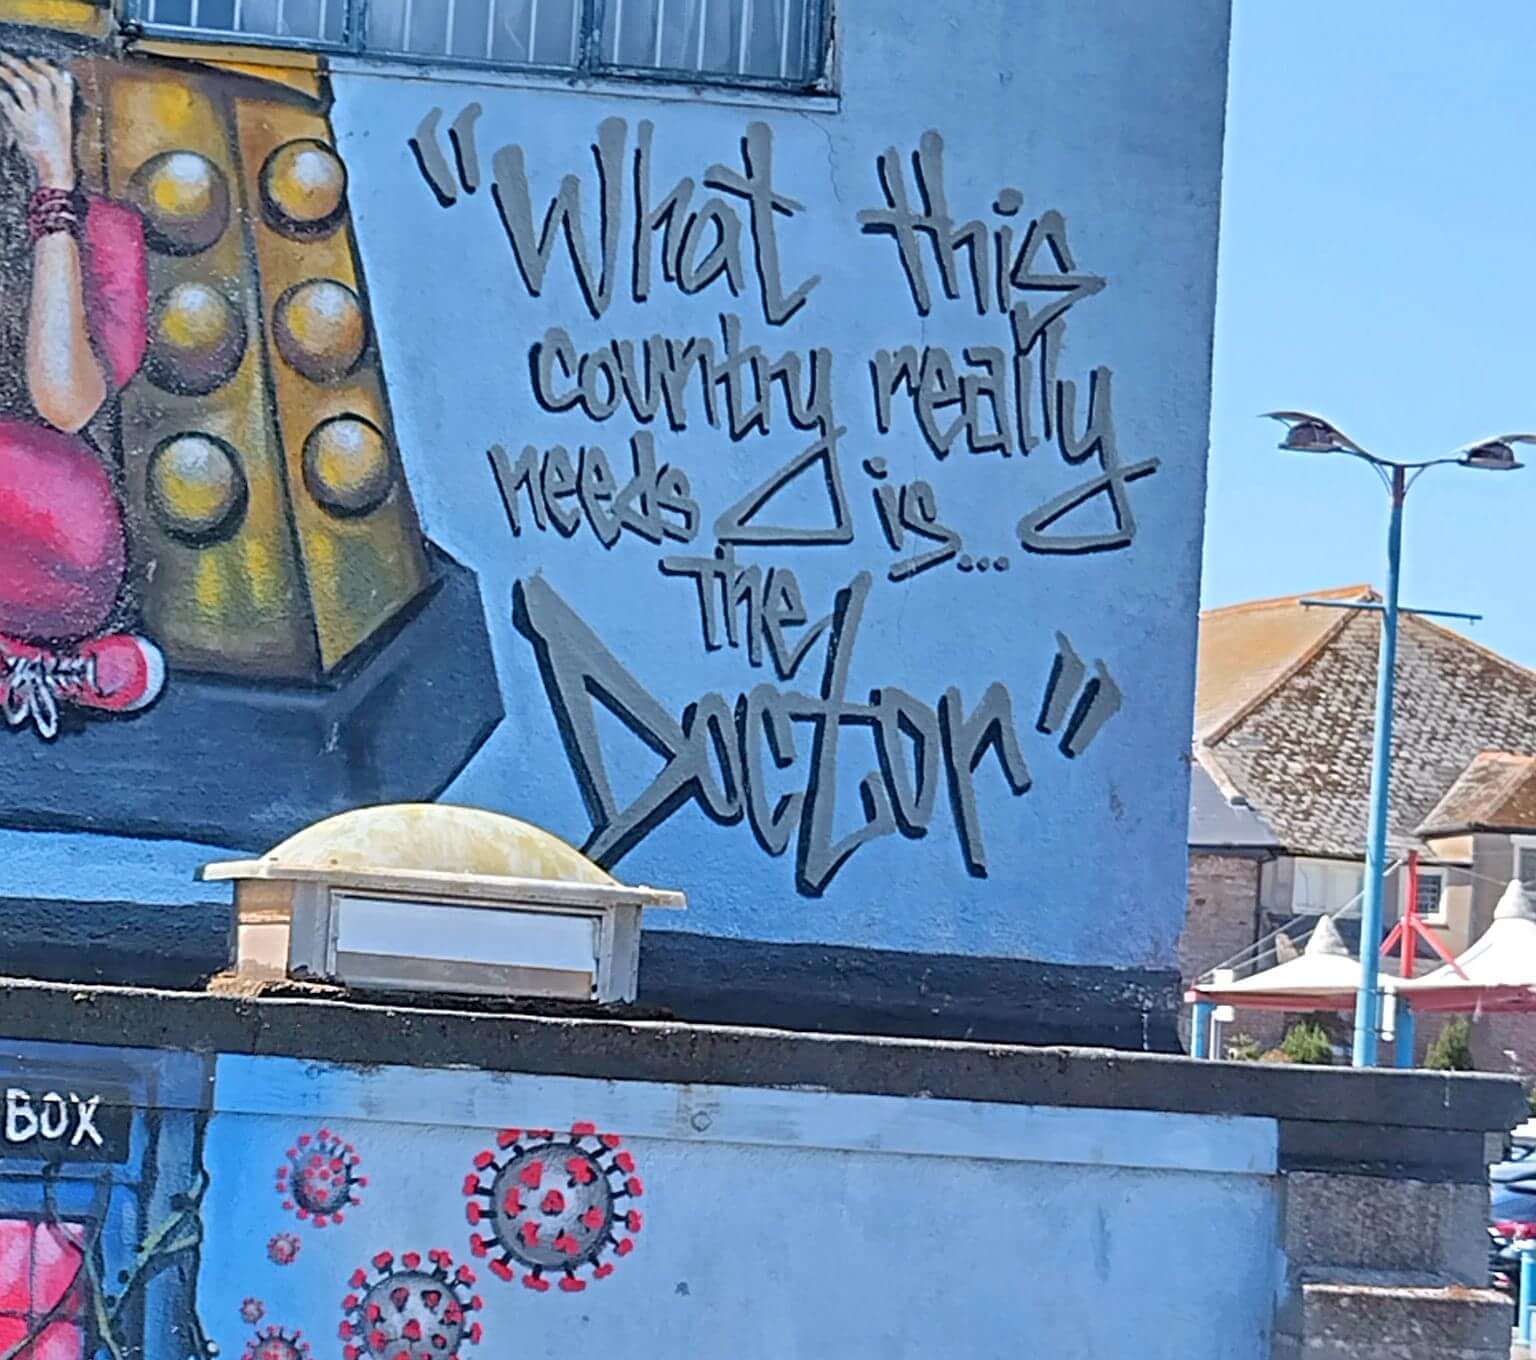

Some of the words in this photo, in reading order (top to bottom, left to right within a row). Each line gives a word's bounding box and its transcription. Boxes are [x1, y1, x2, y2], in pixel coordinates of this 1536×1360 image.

[858, 129, 1106, 346] this
[488, 431, 700, 549] needs
[529, 314, 854, 544] country
[869, 312, 1161, 555] really
[5, 1087, 104, 1146] BOX
